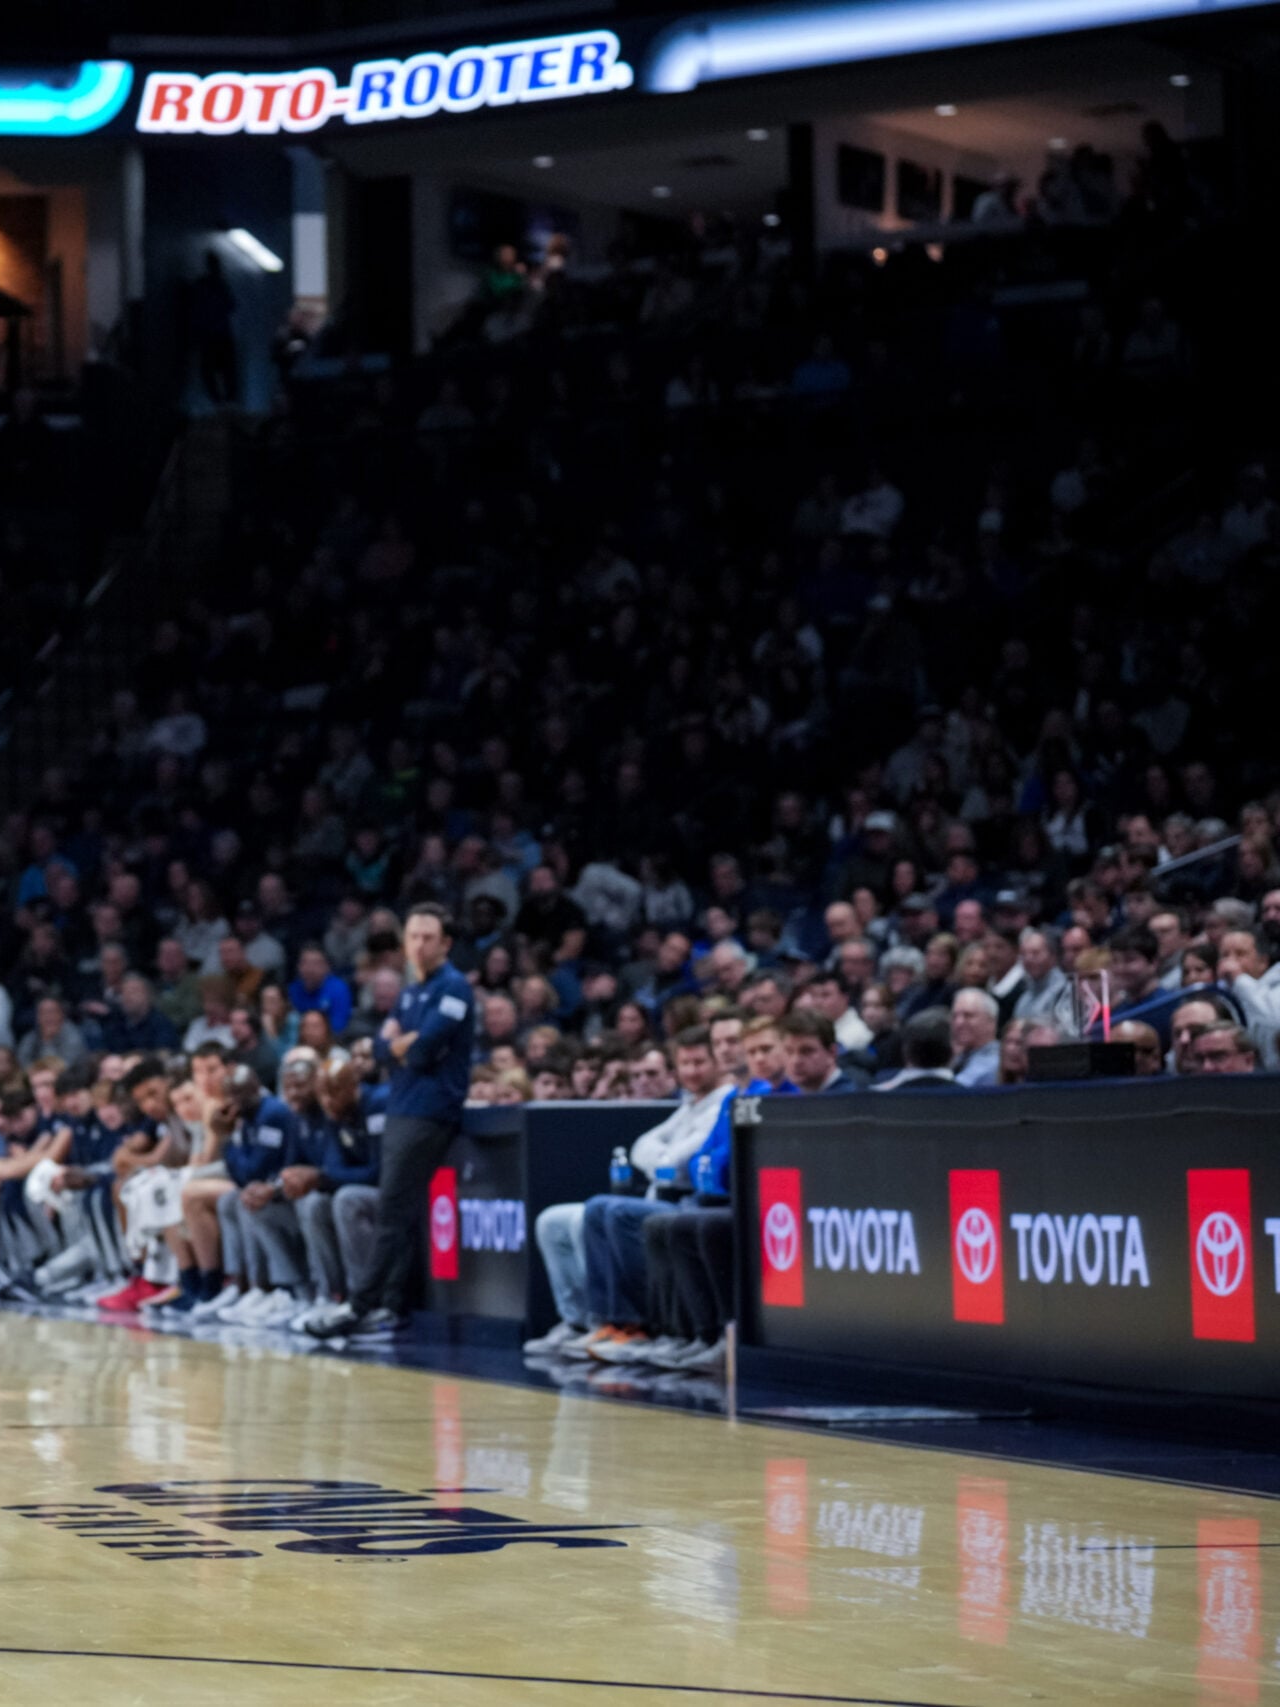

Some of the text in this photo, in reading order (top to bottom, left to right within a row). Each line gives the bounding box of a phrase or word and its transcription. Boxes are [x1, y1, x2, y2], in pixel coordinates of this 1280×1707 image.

[458, 1199, 526, 1253] TOYOTA
[807, 1207, 921, 1275] TOYOTA
[1010, 1213, 1150, 1287] TOYOTA
